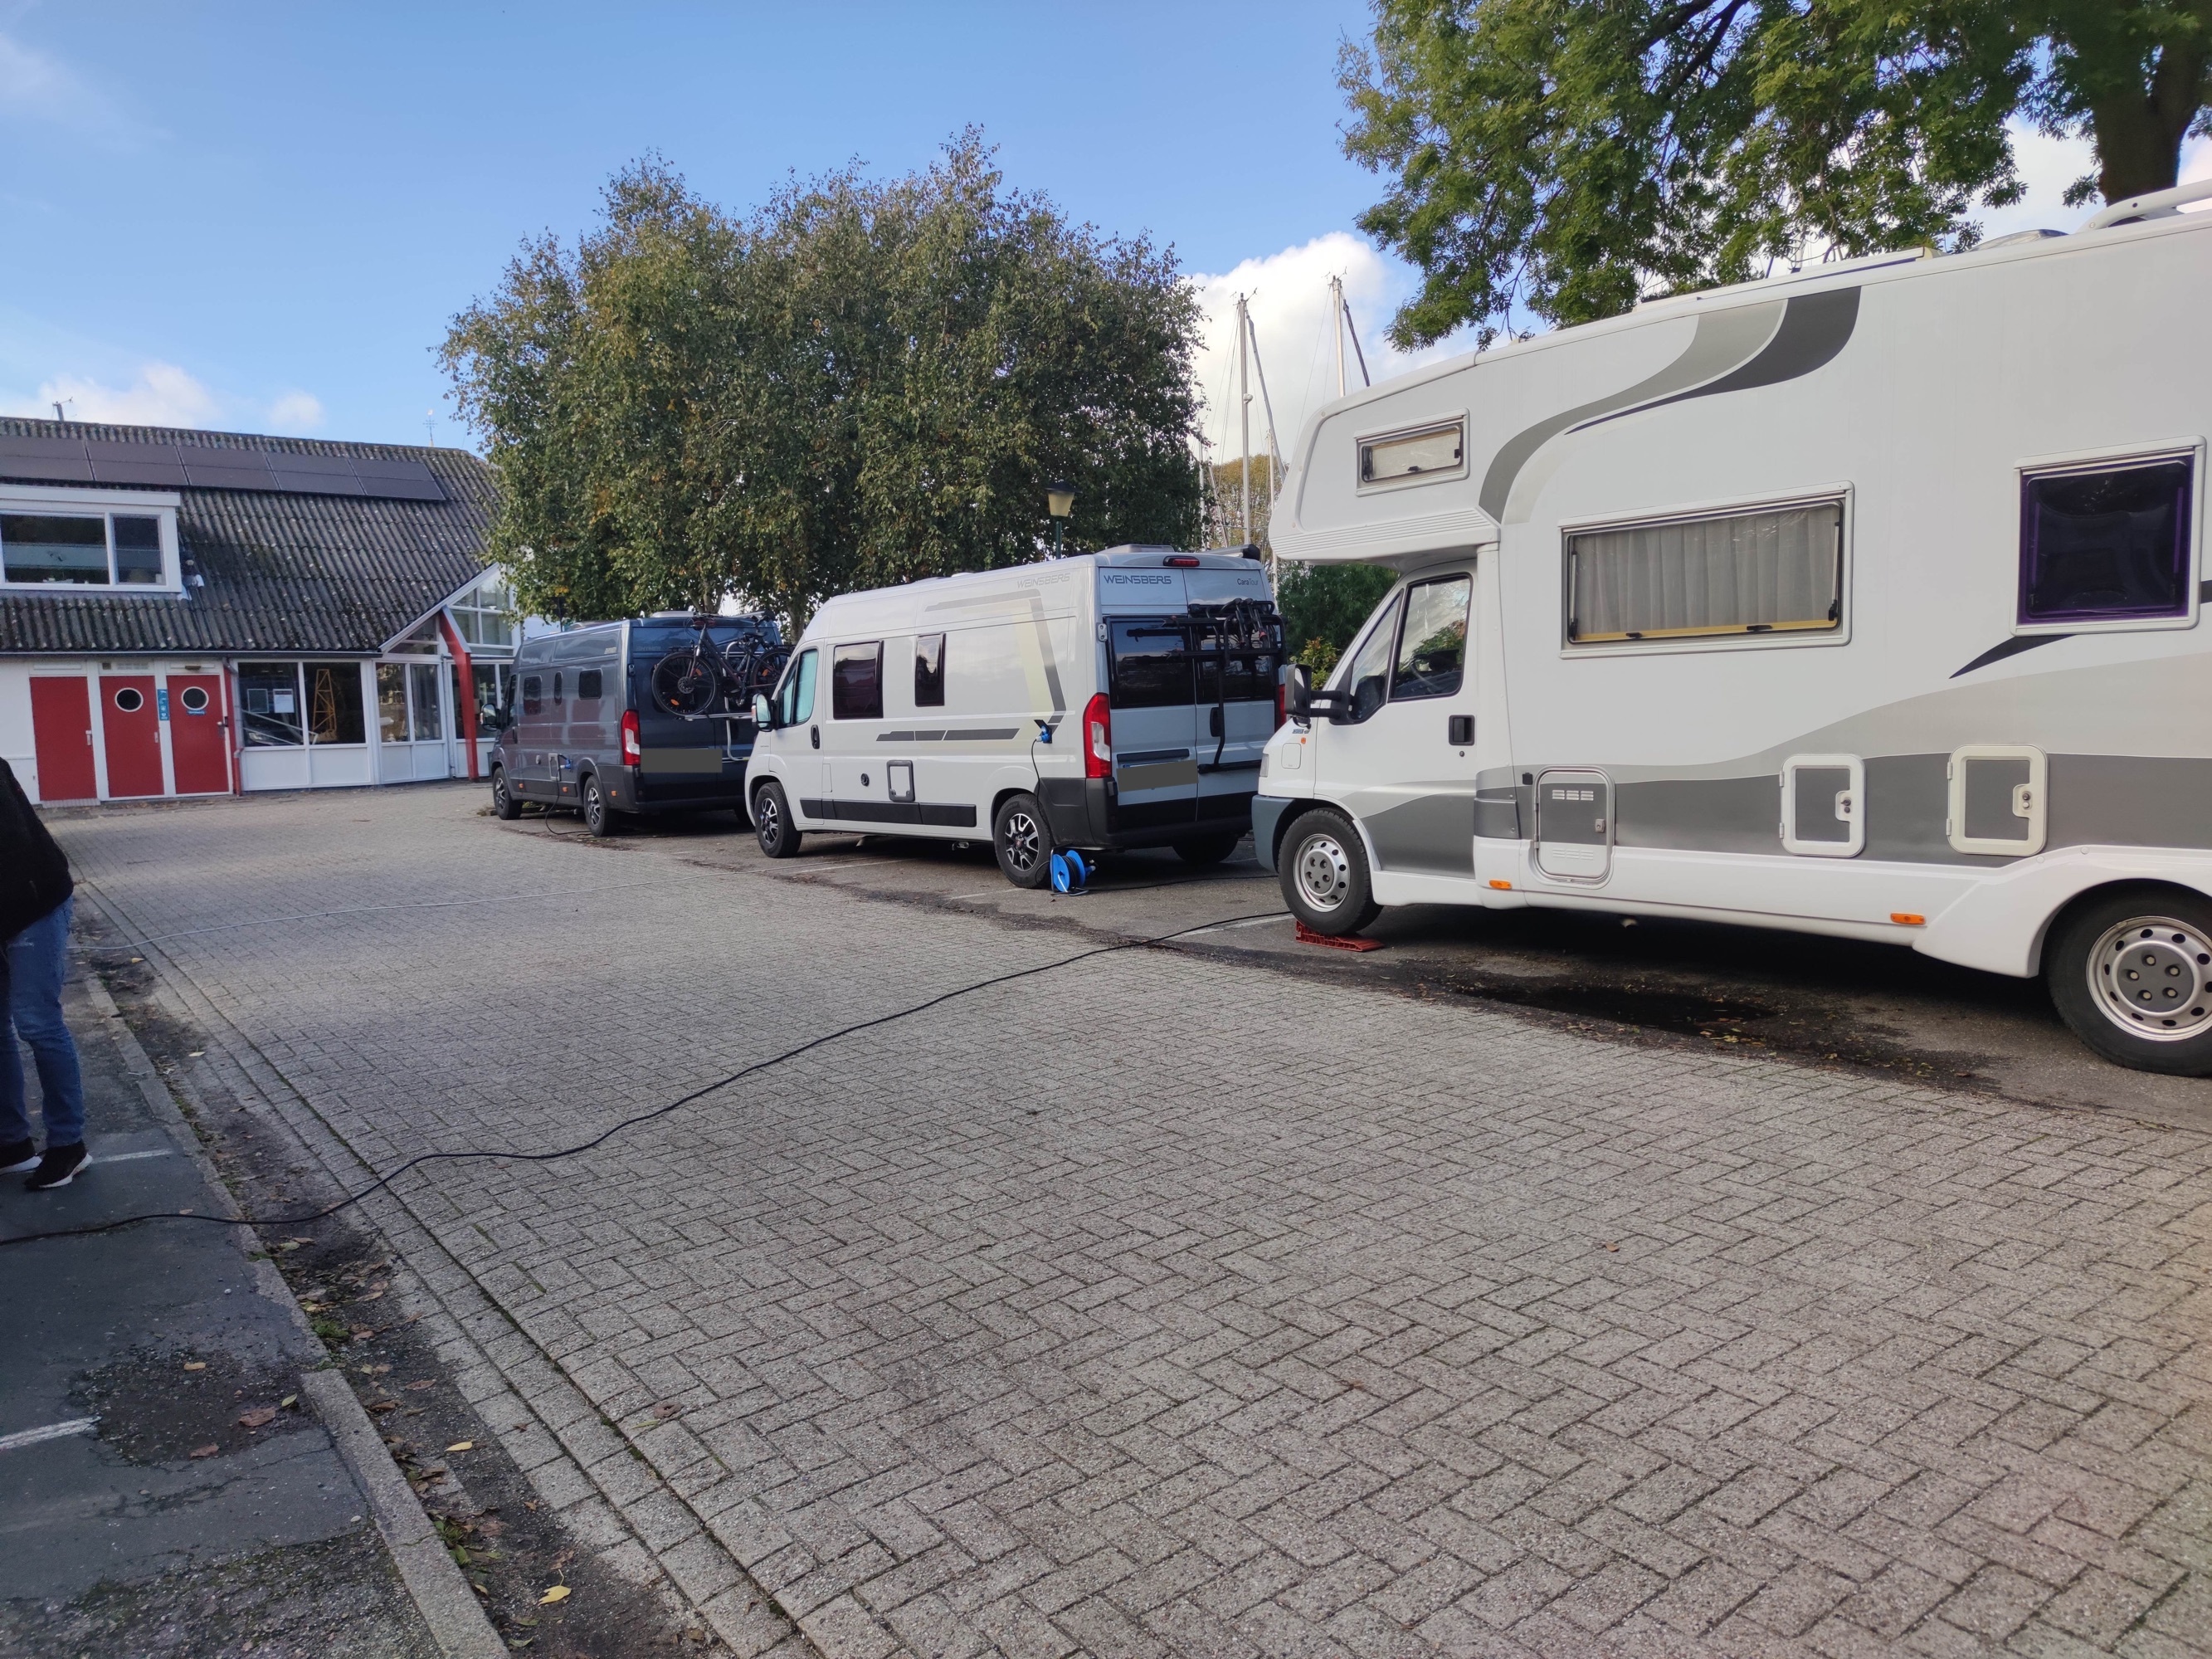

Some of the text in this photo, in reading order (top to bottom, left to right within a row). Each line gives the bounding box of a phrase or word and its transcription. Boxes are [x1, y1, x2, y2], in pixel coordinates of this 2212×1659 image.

[1017, 573, 1070, 588] WEINSBERG
[1104, 575, 1172, 584] WEINSBERG
[1237, 578, 1259, 586] CaraTour
